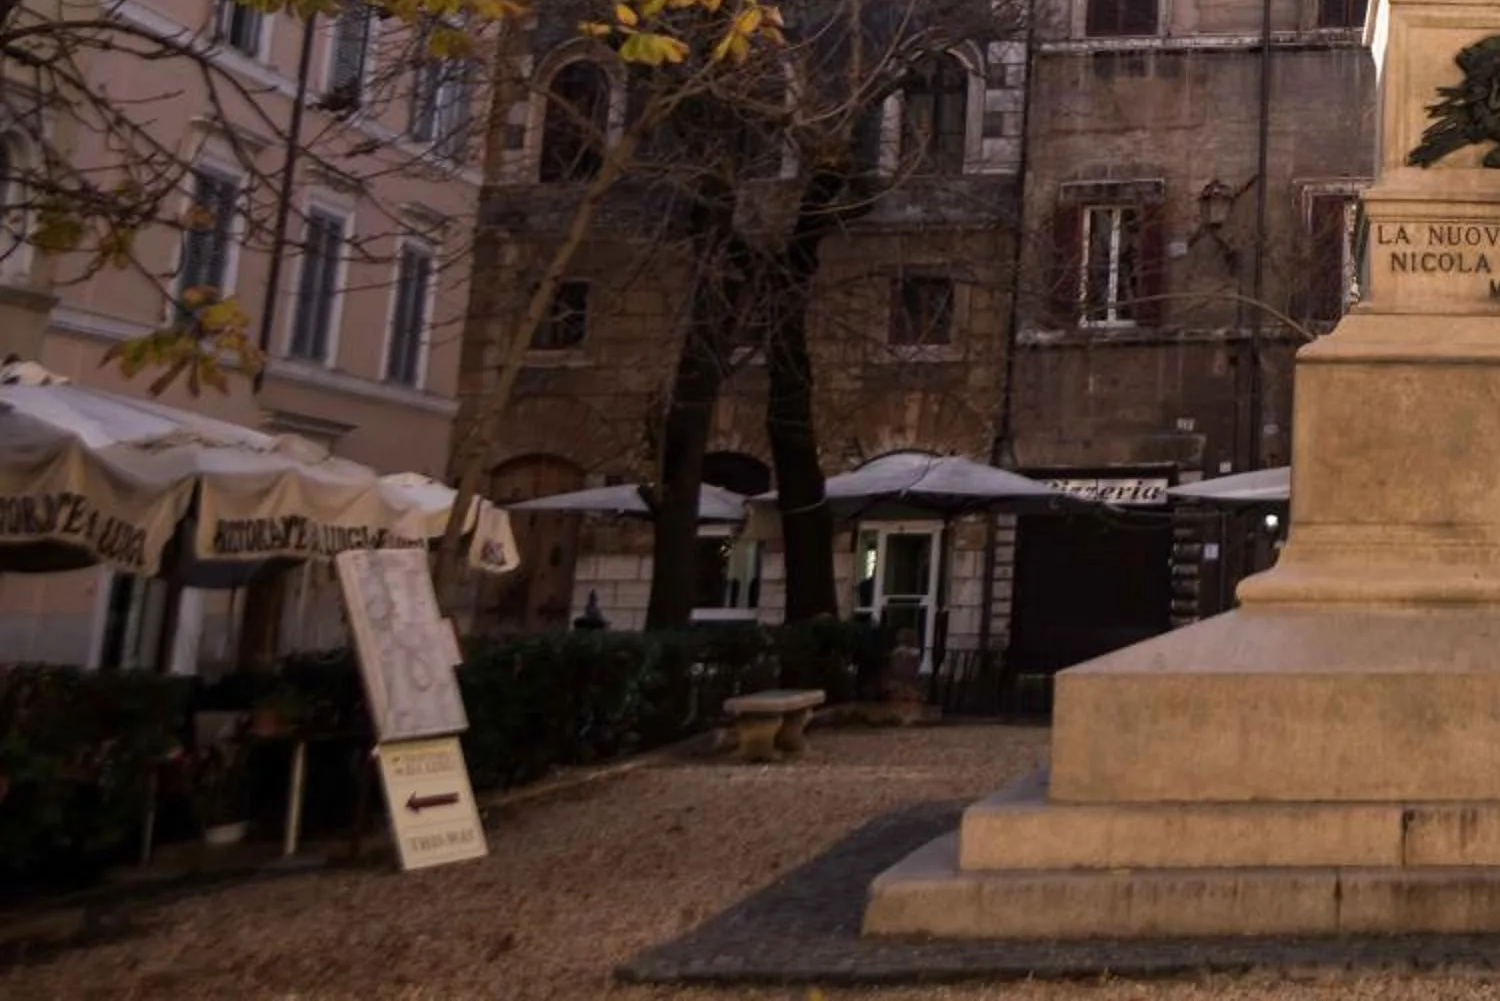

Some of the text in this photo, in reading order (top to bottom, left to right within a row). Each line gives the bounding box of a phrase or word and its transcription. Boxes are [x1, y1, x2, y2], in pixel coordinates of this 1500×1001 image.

[1376, 224, 1411, 246] LA
[1390, 252, 1492, 273] NICOLA
[1046, 478, 1163, 500] zeria
